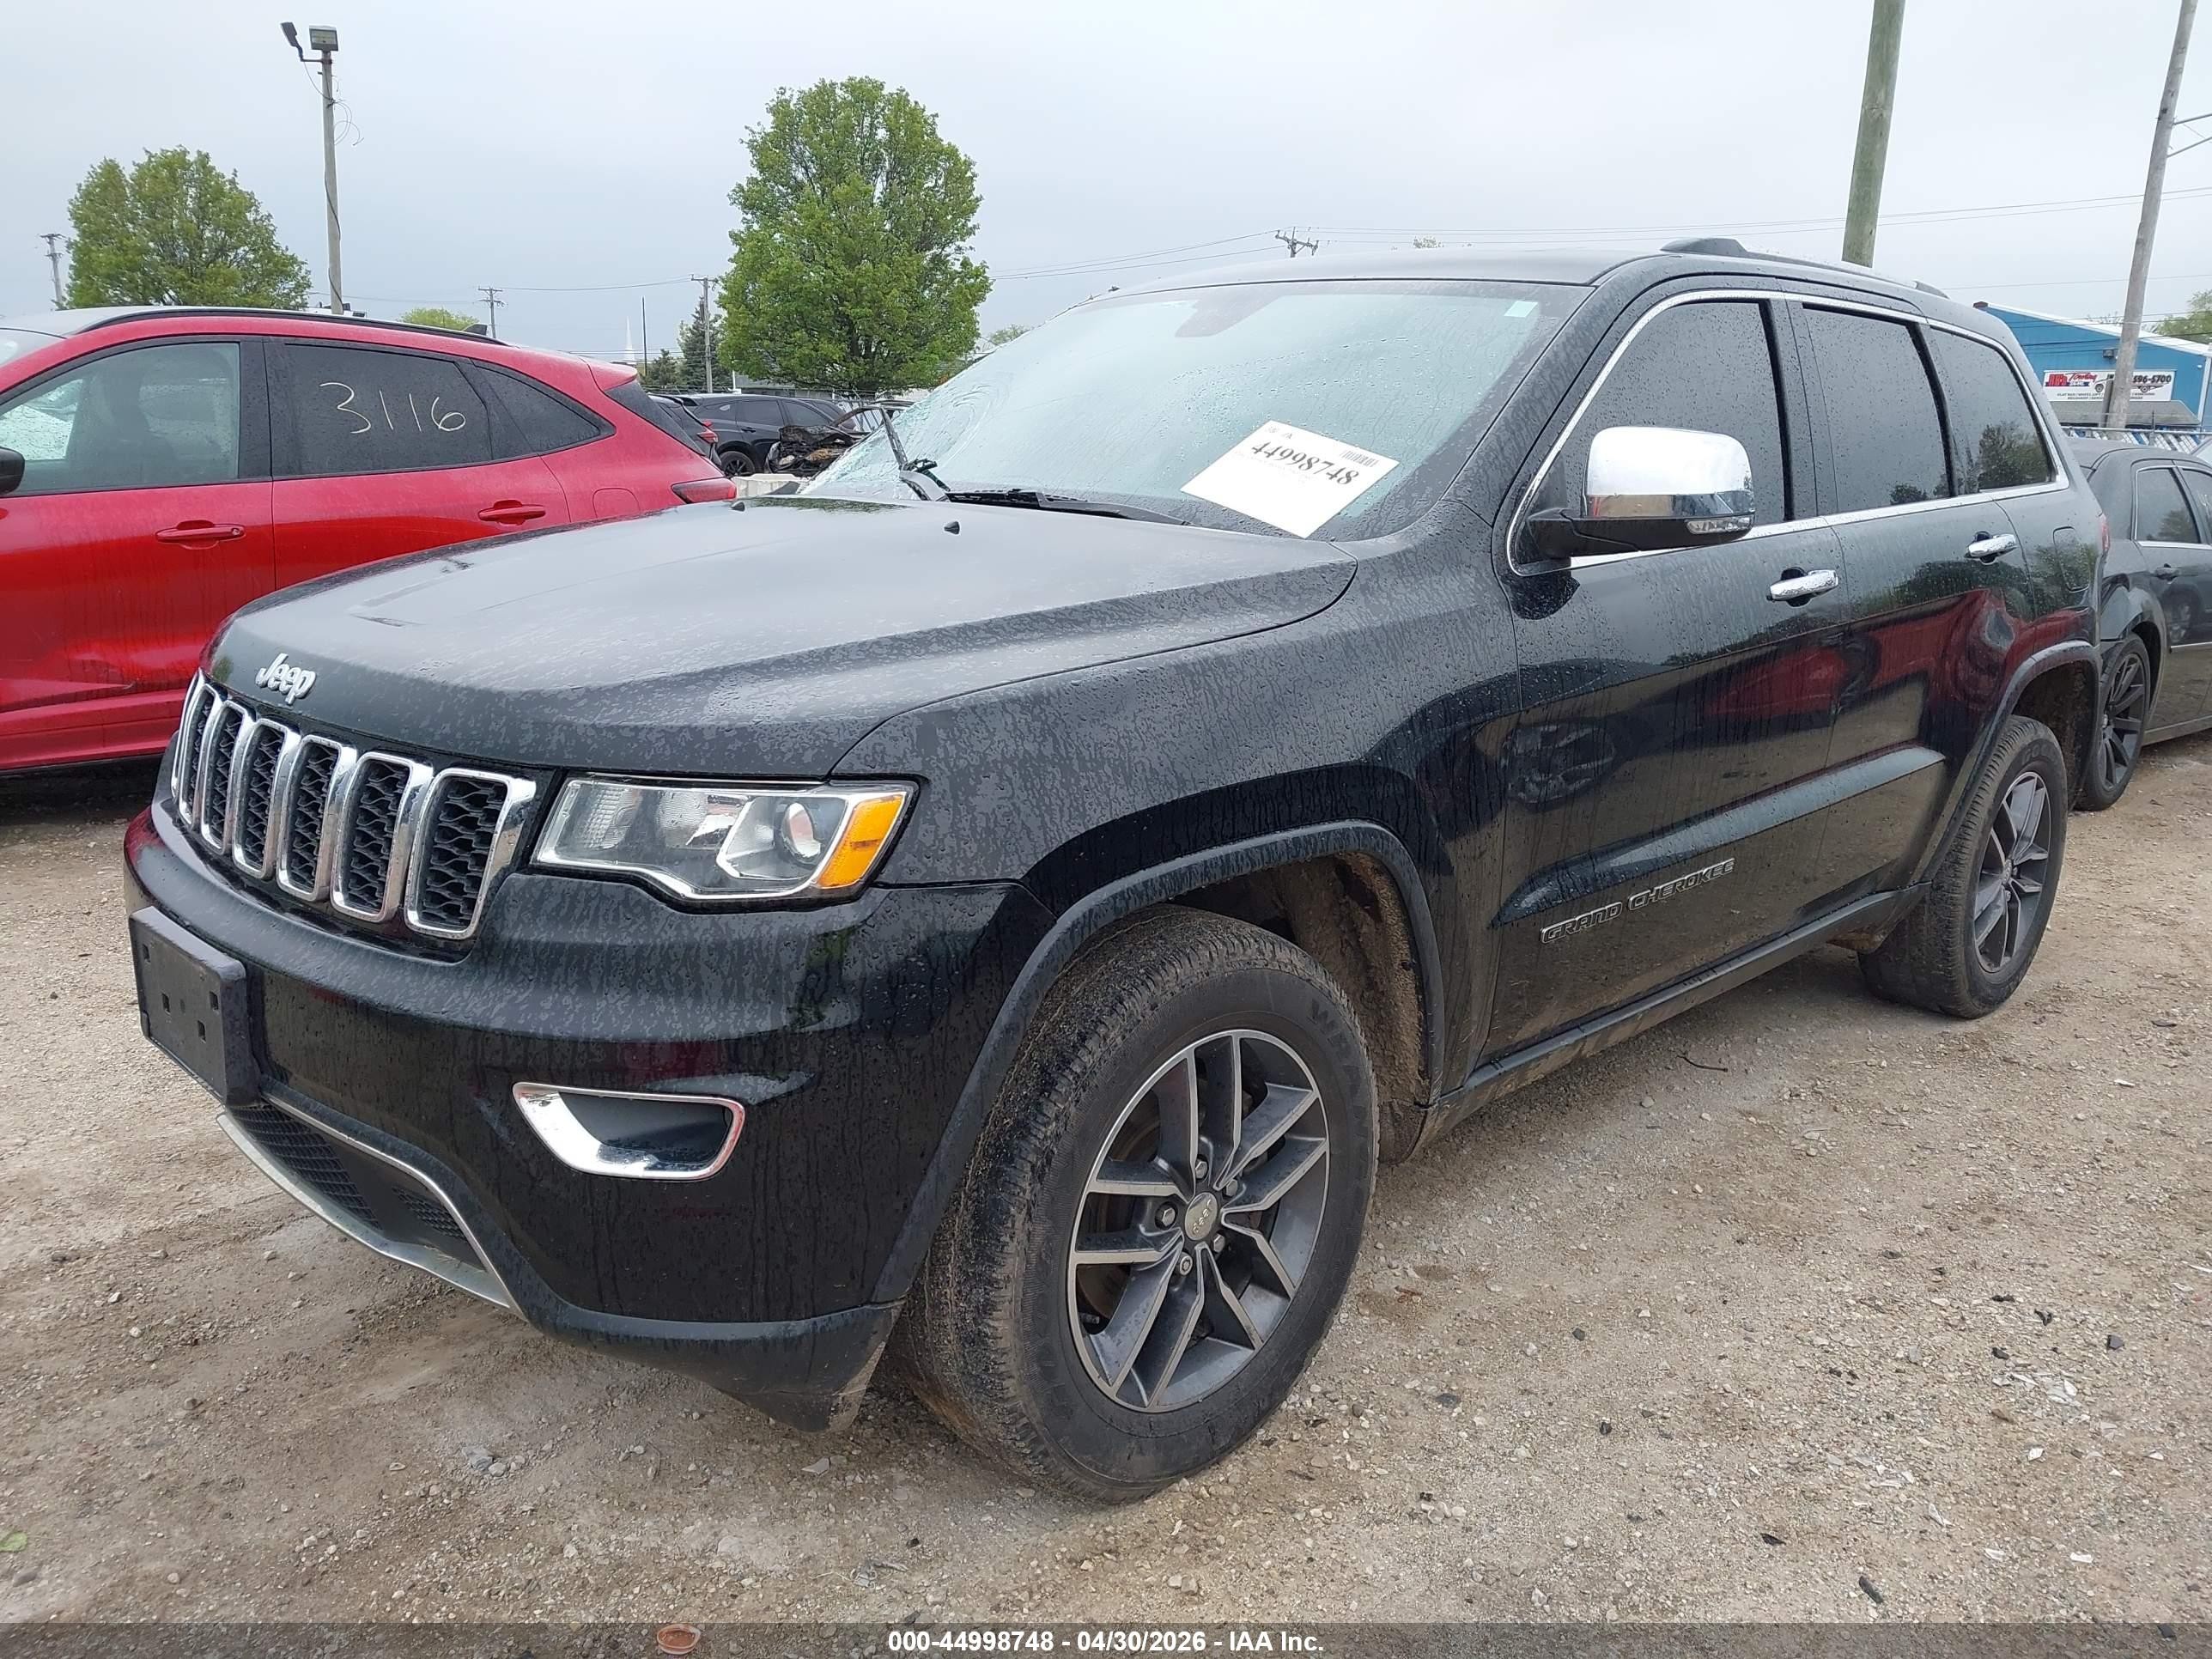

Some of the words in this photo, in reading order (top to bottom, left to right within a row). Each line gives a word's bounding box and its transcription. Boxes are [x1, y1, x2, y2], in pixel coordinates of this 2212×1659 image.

[2133, 374, 2172, 383] 596-5700
[319, 381, 466, 434] 3116
[1251, 441, 1359, 484] 44998748
[255, 653, 316, 704] Jeep
[1540, 901, 1623, 944] GRAND
[1628, 858, 1735, 911] CHEROKEE
